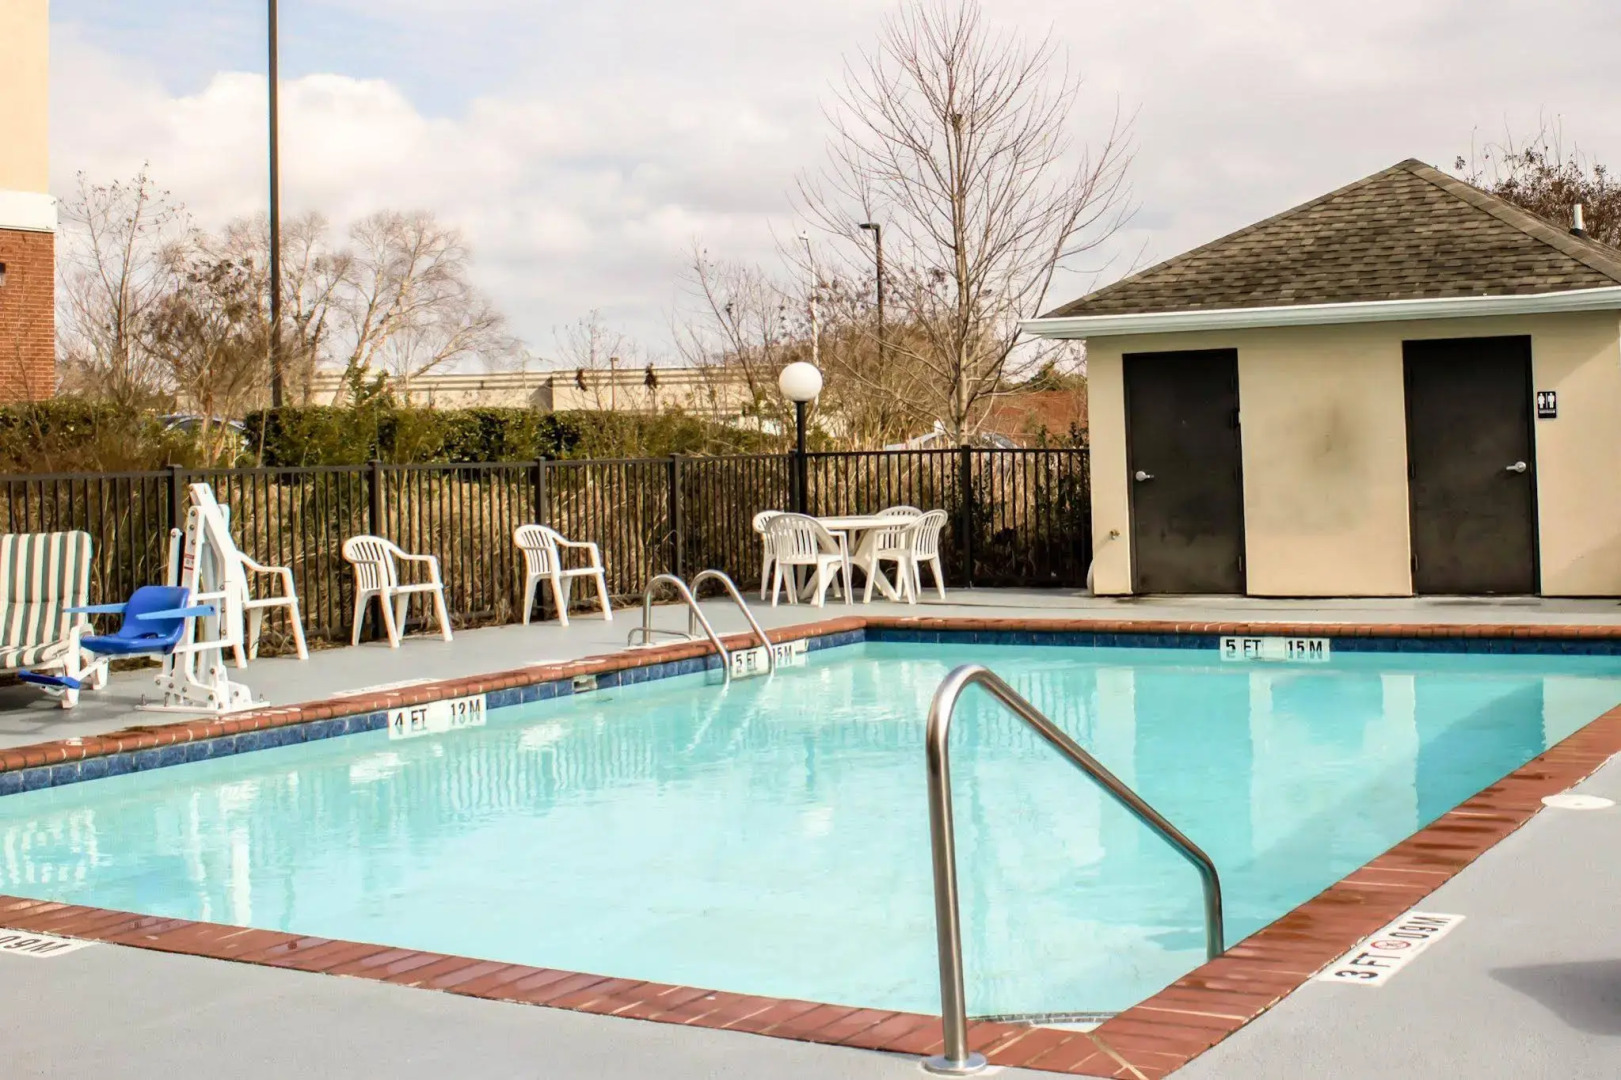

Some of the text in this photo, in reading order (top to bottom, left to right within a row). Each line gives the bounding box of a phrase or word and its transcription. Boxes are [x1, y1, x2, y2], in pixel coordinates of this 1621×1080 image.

[1225, 639, 1236, 651] 5
[1243, 639, 1261, 651] FT
[735, 654, 743, 667] 5
[746, 651, 757, 662] FT
[394, 712, 403, 725] 4
[411, 709, 427, 722] FT
[1334, 916, 1451, 979] 3 FT 09M
